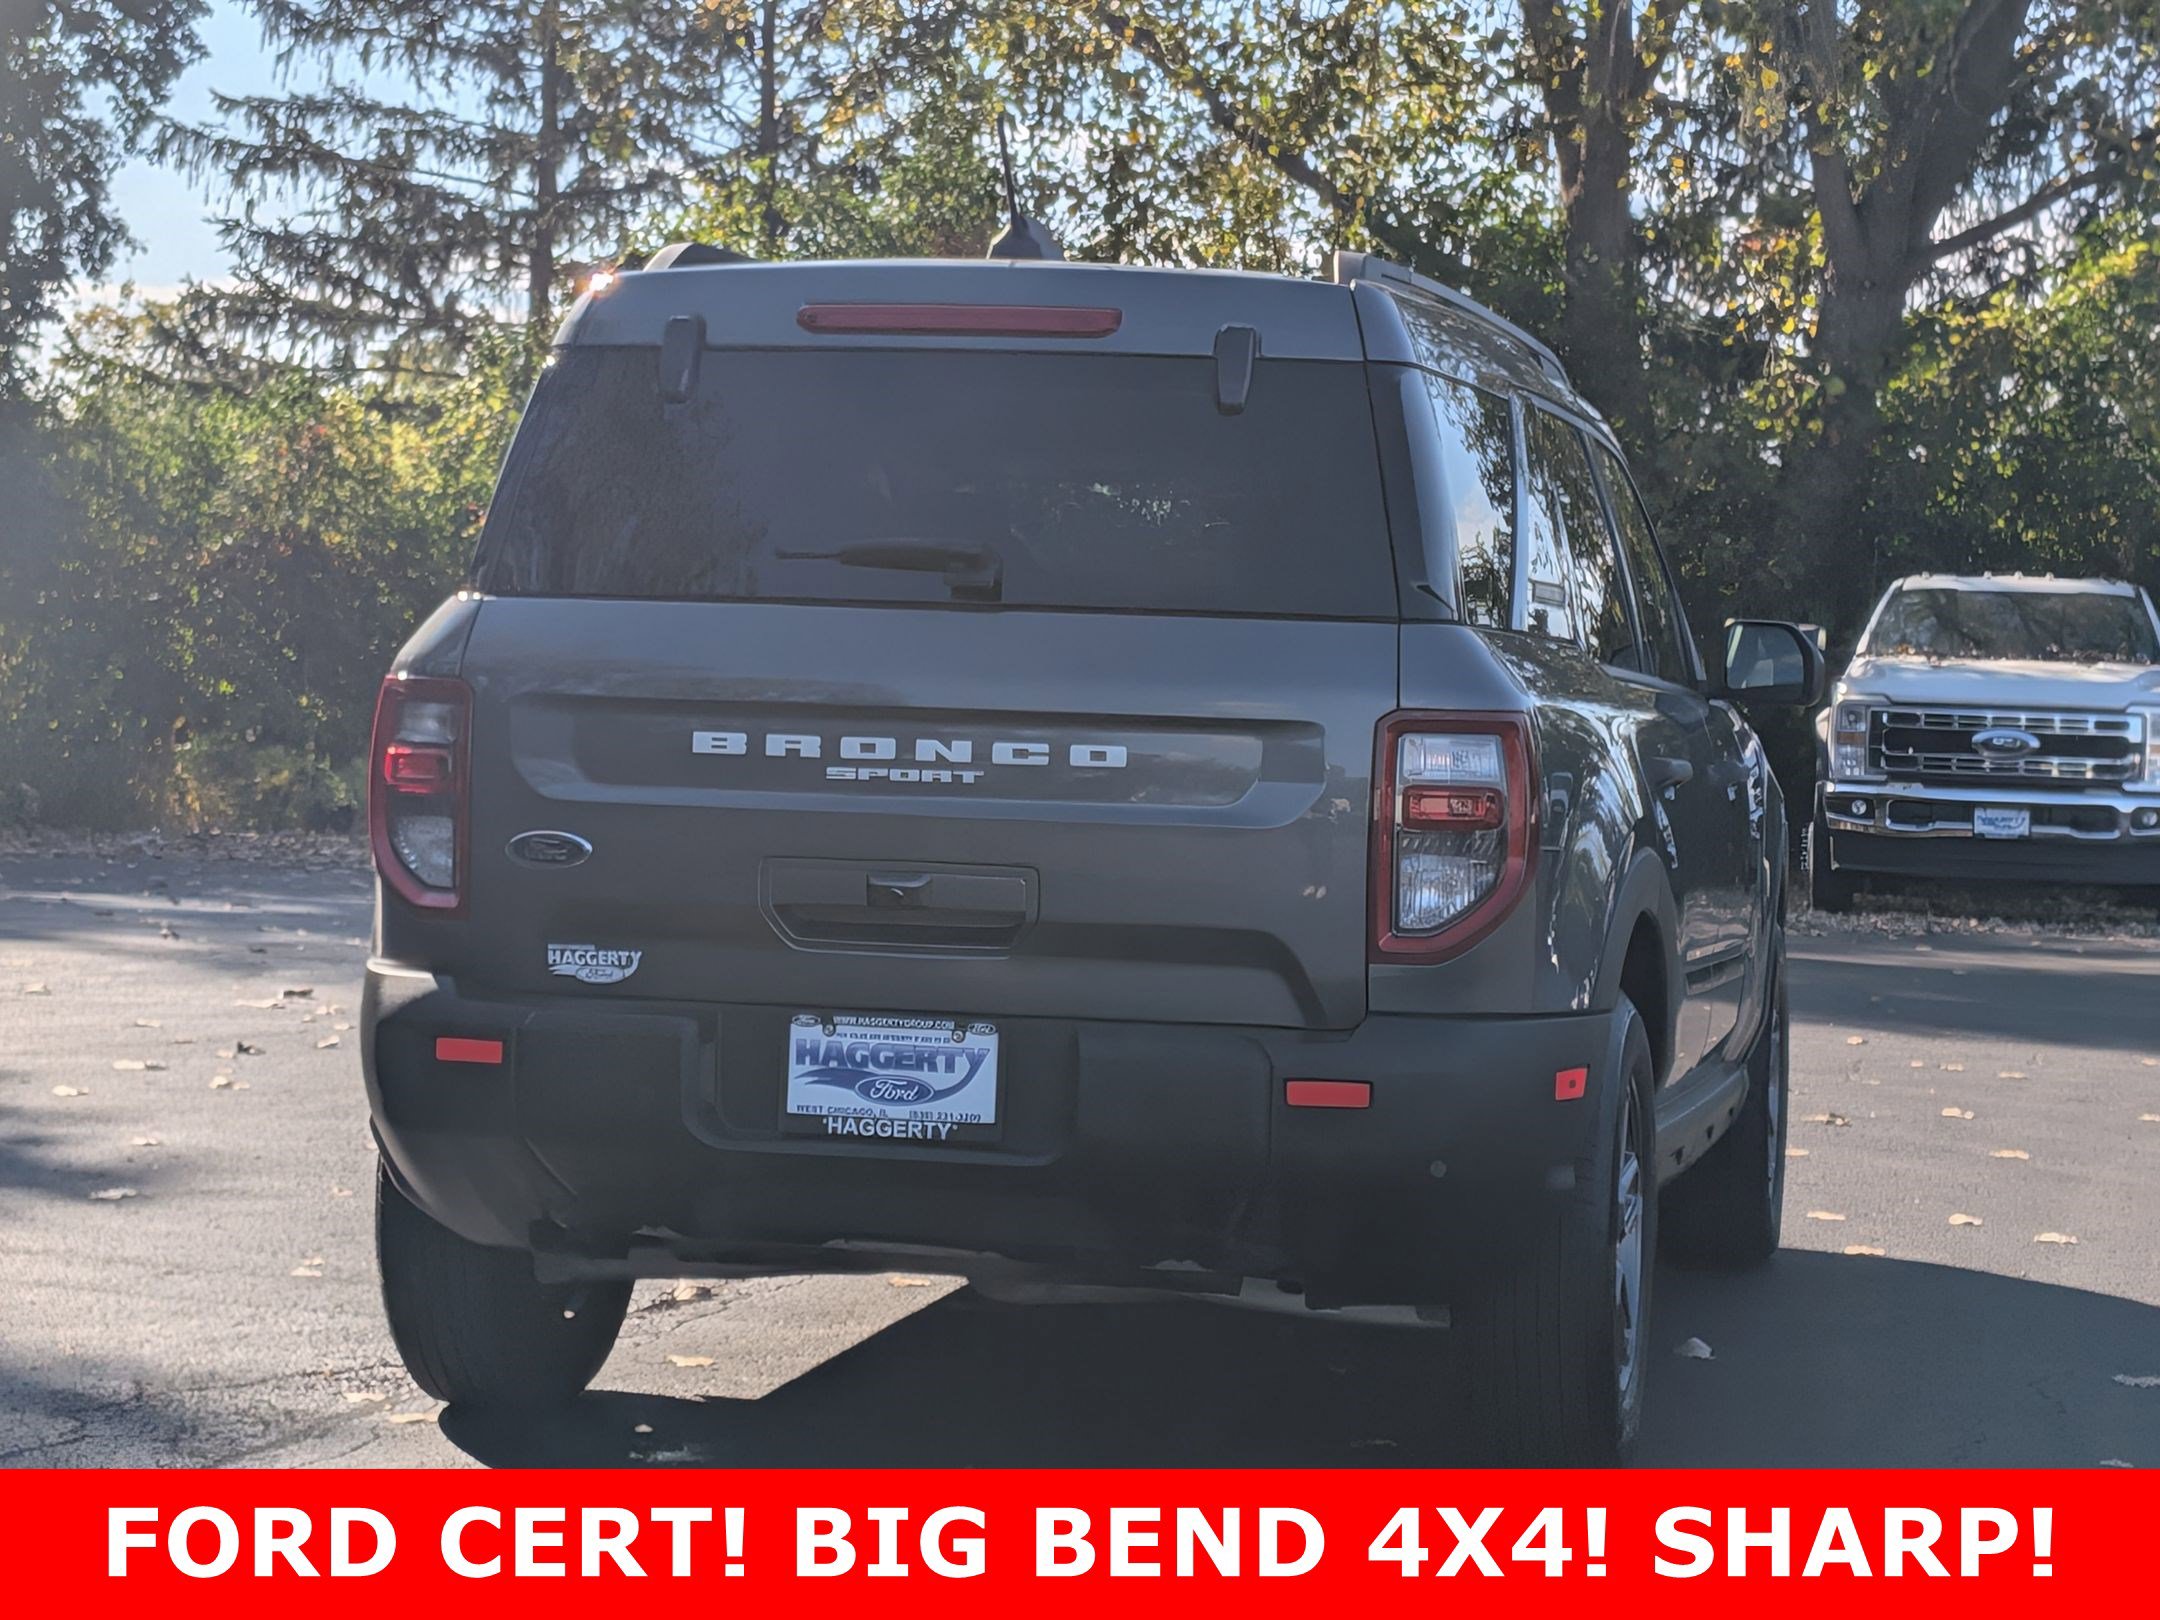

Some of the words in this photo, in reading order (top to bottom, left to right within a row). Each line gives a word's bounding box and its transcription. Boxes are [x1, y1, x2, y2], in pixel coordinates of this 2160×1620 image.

[691, 730, 1128, 768] BRONCO
[825, 766, 984, 783] SPORT
[548, 950, 642, 966] HAGGERTY
[795, 1038, 991, 1074] HAGGERTY
[870, 1079, 918, 1100] Ford
[796, 1104, 823, 1114] WEST
[826, 1117, 953, 1140] HAGGERTY
